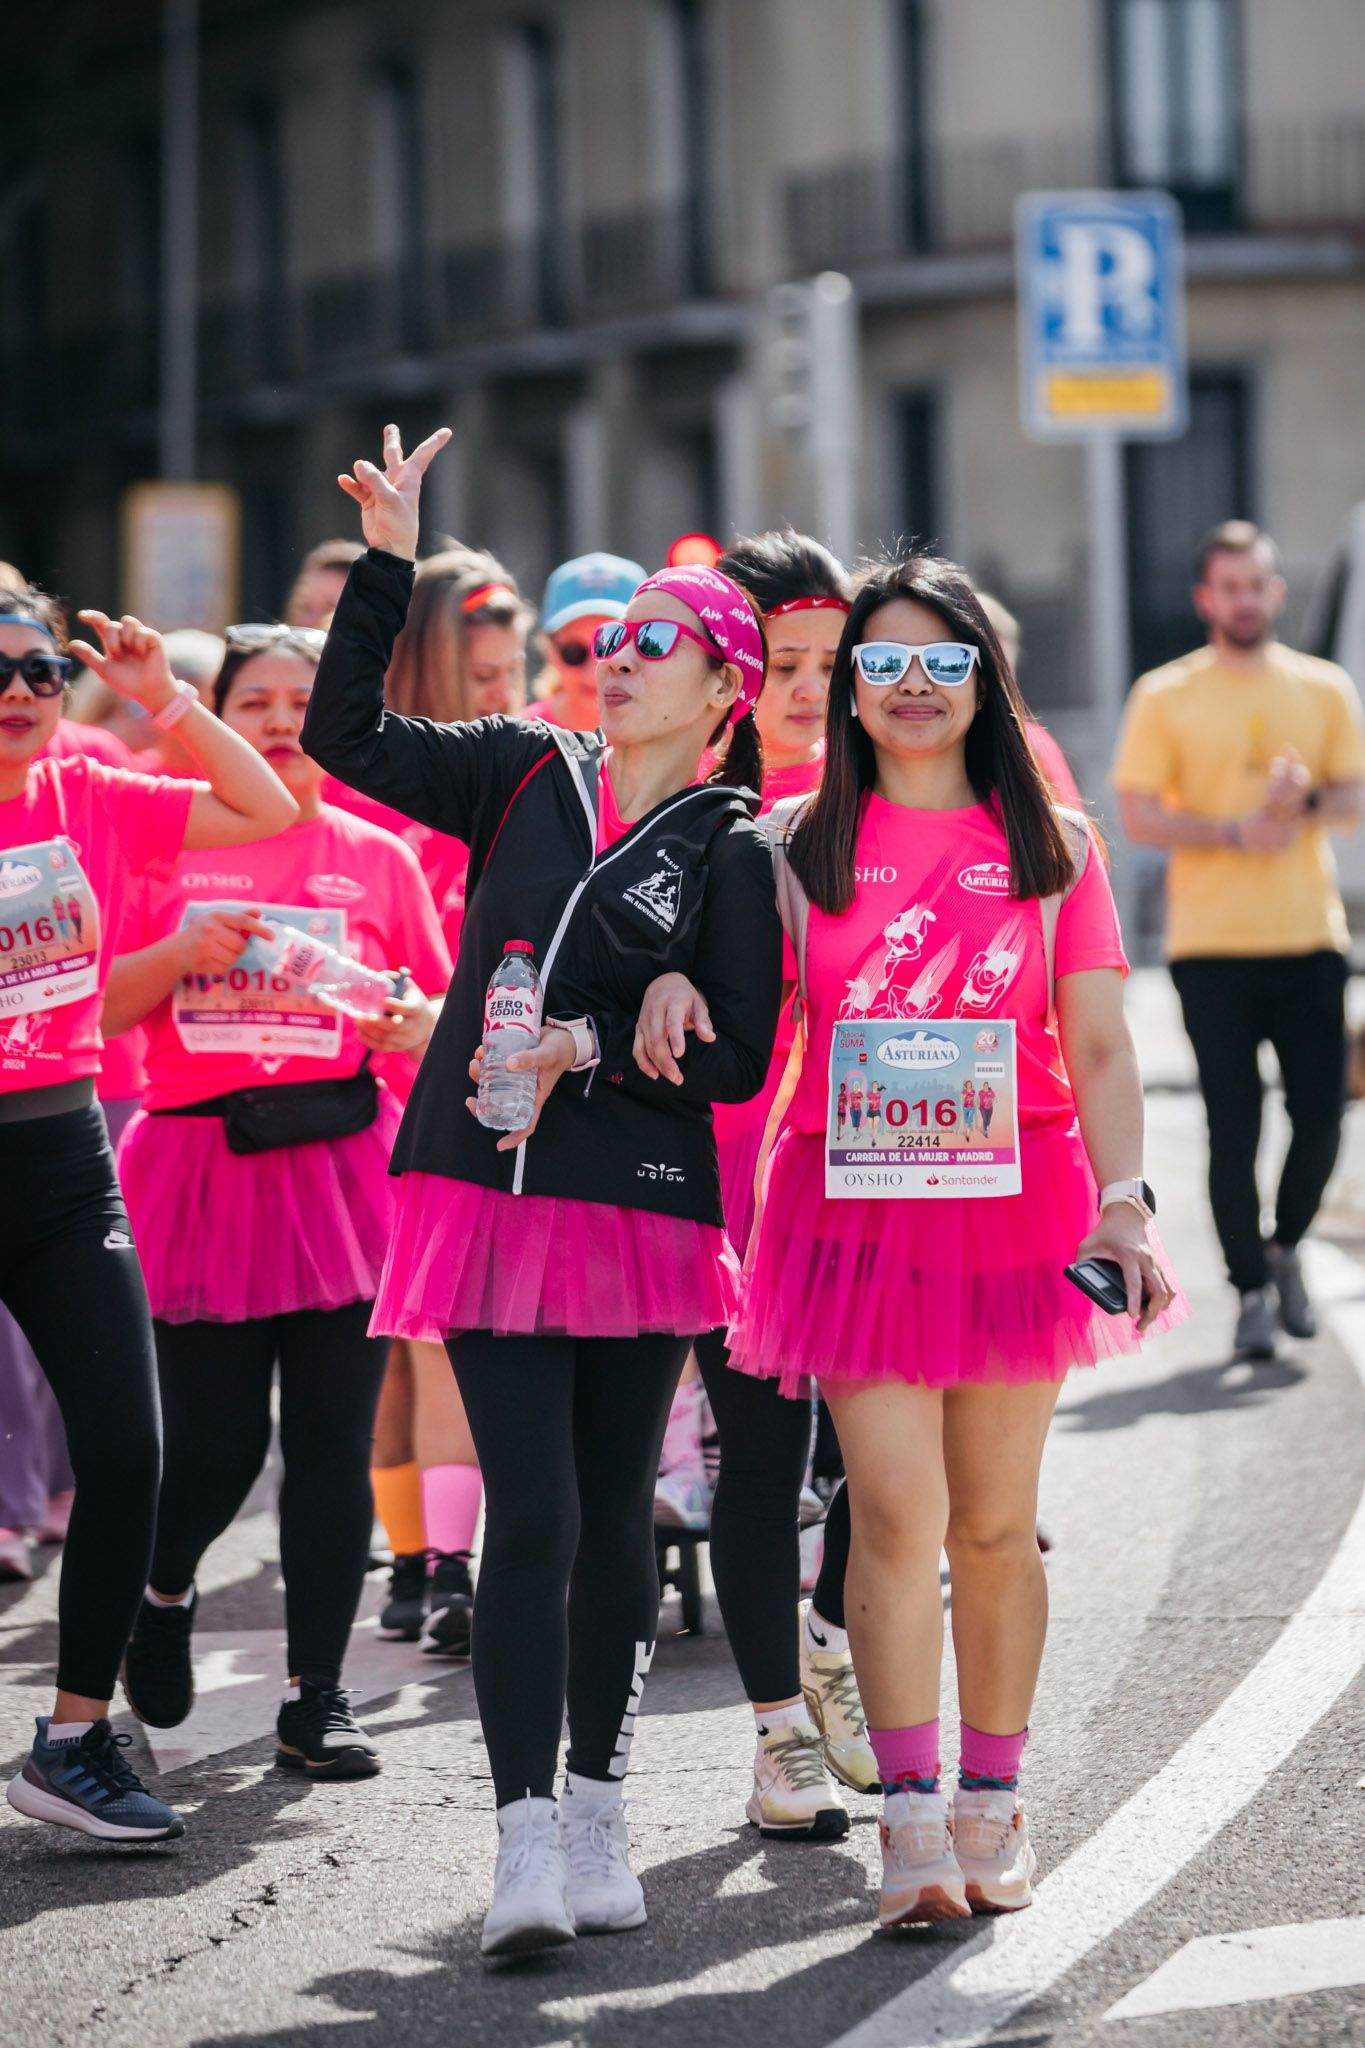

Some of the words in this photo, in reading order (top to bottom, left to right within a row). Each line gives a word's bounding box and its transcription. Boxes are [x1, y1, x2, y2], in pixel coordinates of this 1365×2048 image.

[633, 899, 659, 923] RUNNING
[0, 917, 55, 952] 016
[490, 999, 523, 1010] ZERO
[489, 1008, 523, 1018] SODIO
[840, 1038, 865, 1048] SUMA
[978, 1031, 997, 1046] 20
[882, 1045, 956, 1061] ASTURIANA
[886, 1099, 957, 1127] 016
[897, 1136, 941, 1148] 22414
[845, 1152, 886, 1162] CARRERA
[888, 1152, 901, 1162] DE
[903, 1152, 916, 1162] LA
[918, 1152, 949, 1162] MUJER
[956, 1151, 994, 1162] MADRID
[844, 1172, 903, 1187] OYSHO
[941, 1174, 998, 1186] Santander
